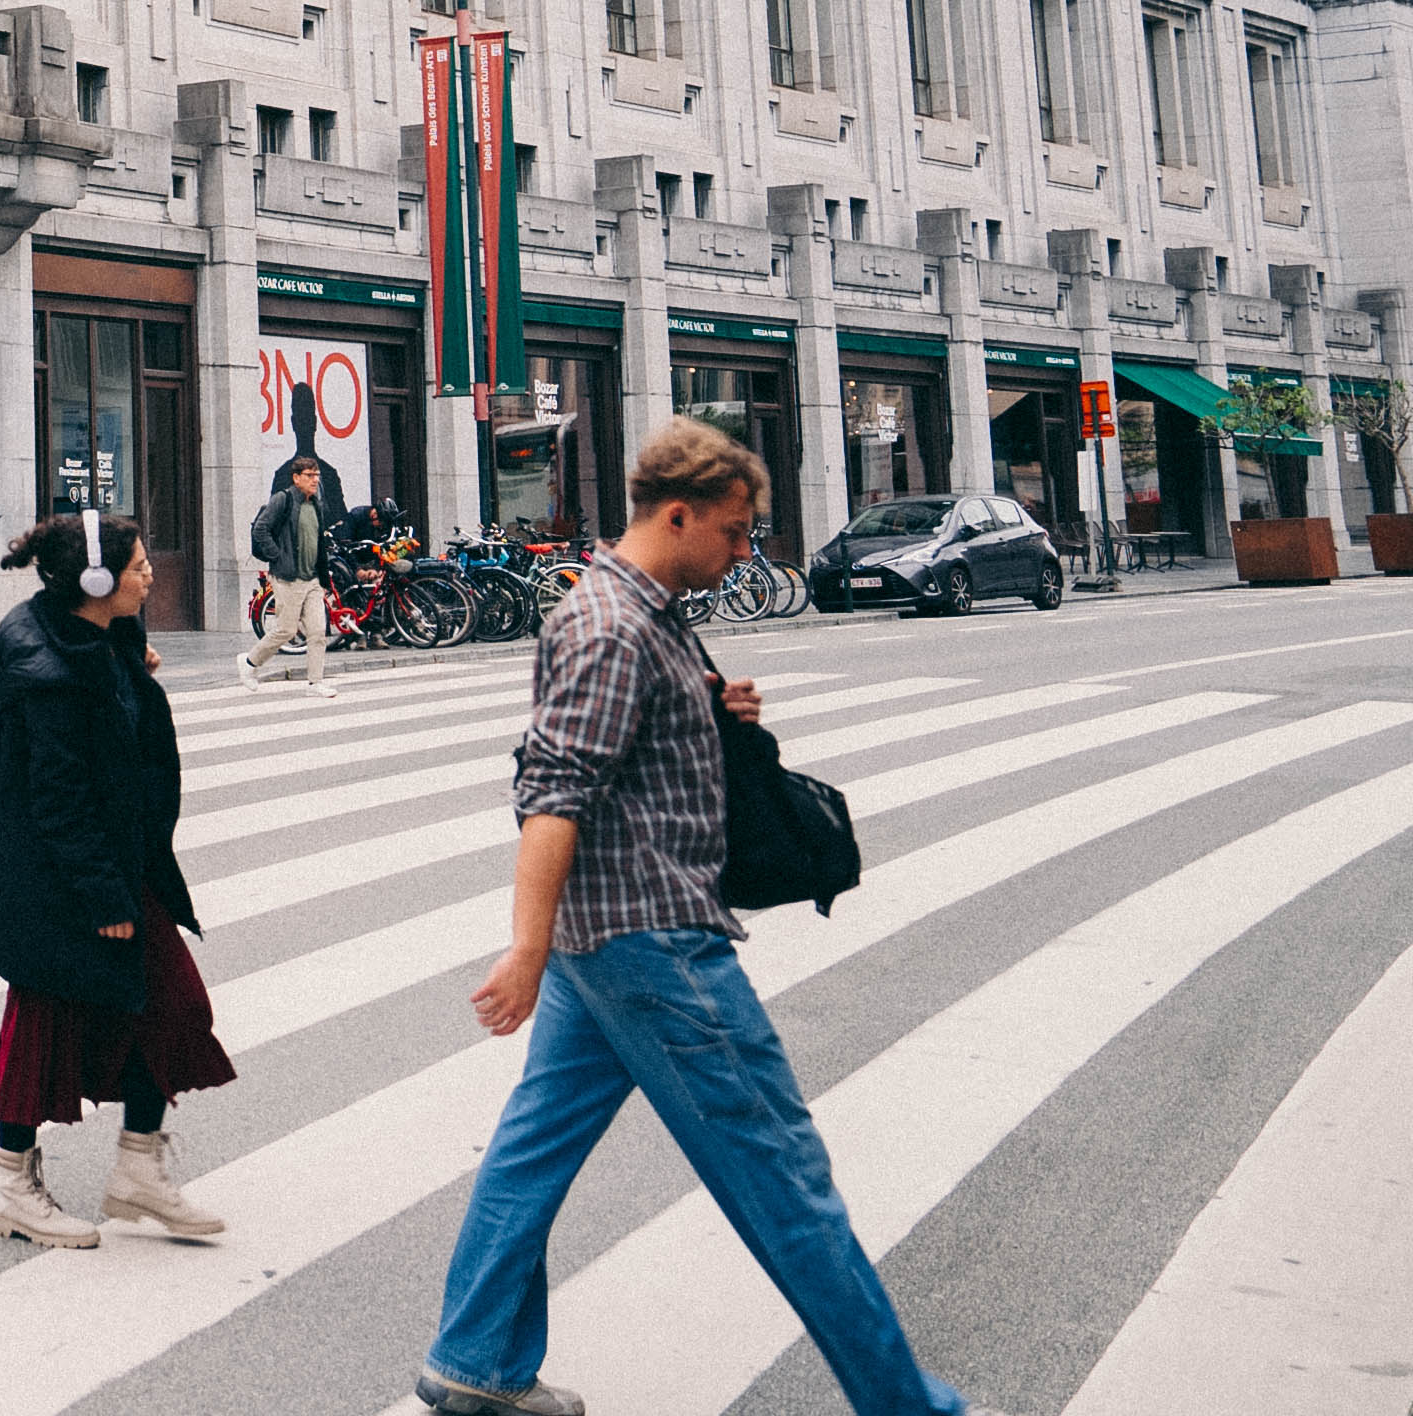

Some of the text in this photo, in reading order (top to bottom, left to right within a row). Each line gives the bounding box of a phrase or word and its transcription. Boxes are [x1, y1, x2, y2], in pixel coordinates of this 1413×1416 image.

[428, 102, 436, 118] des
[429, 120, 437, 146] Palais
[483, 120, 492, 142] voor
[534, 379, 559, 395] Bozar
[537, 395, 558, 410] Café
[534, 410, 561, 424] Victor
